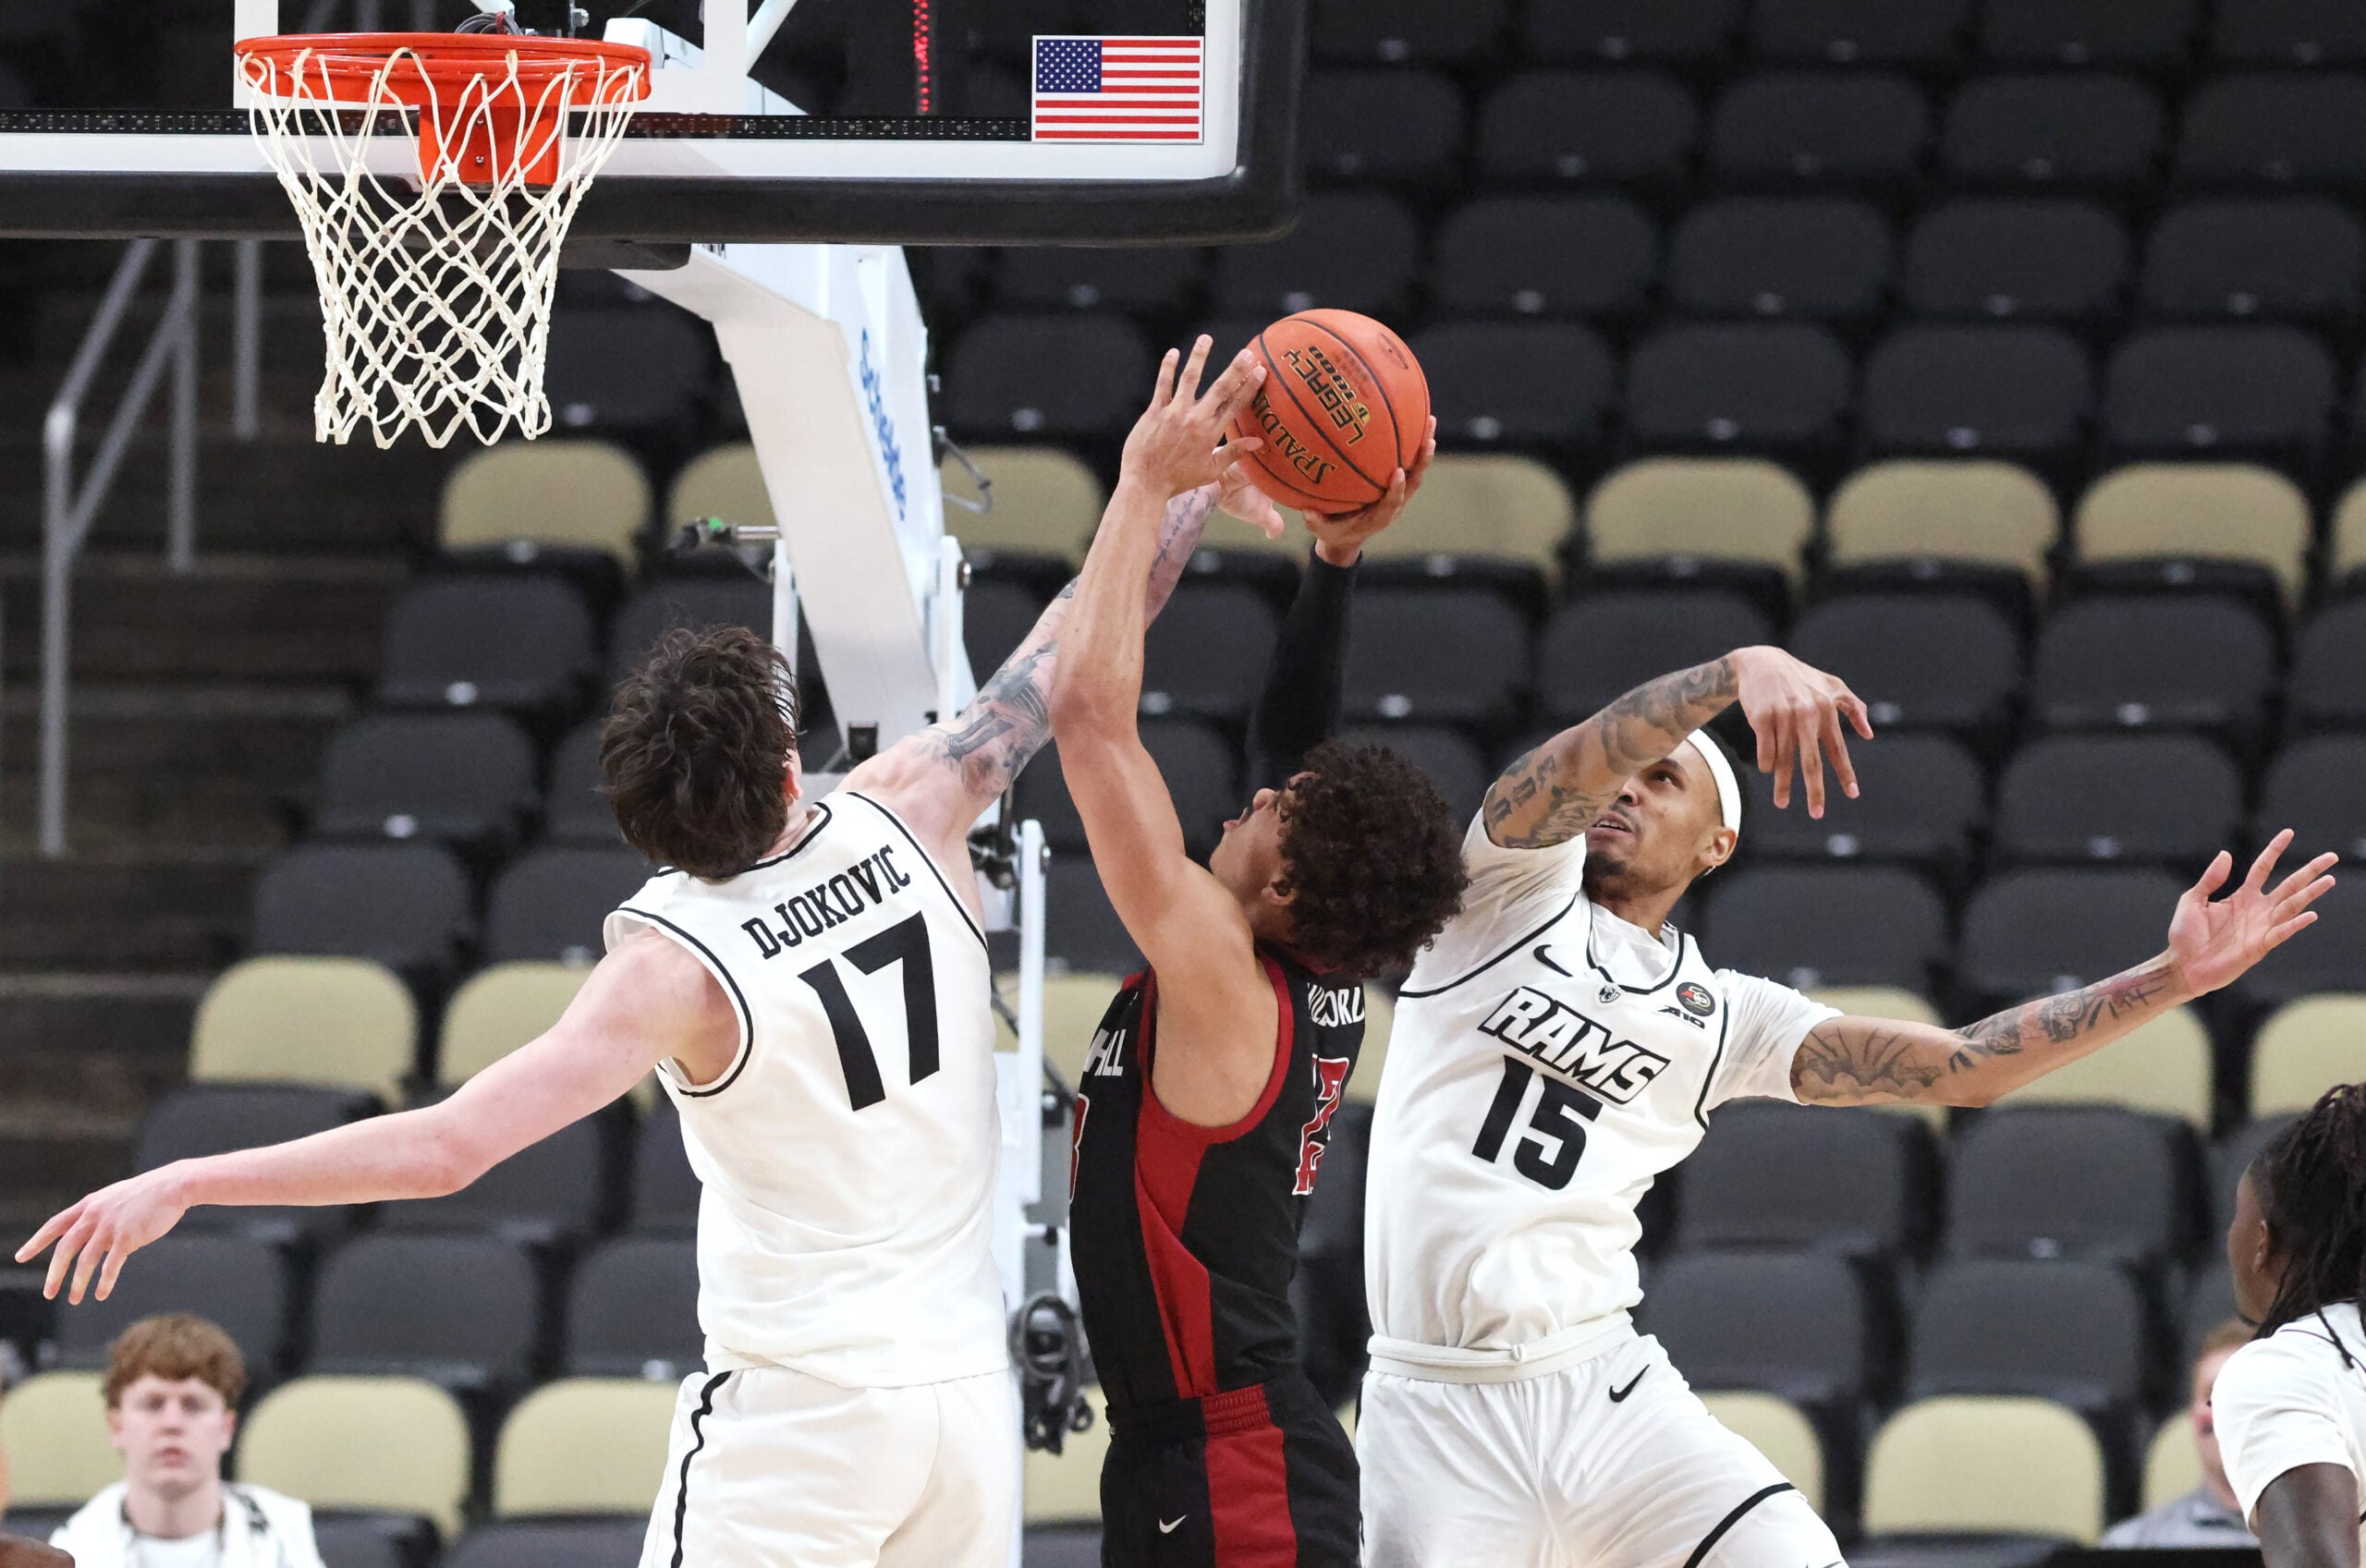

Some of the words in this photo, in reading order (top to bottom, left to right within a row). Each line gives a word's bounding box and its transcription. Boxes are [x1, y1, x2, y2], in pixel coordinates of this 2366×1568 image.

[1281, 347, 1365, 446] LEGACY
[1308, 346, 1356, 402] 1000
[1250, 385, 1336, 484] SPALDIN
[740, 845, 911, 960] DJOKOVIC
[797, 909, 940, 1112] 17
[1477, 985, 1672, 1105] RAMS
[1657, 1004, 1705, 1029] A10
[1471, 1053, 1604, 1191] 15
